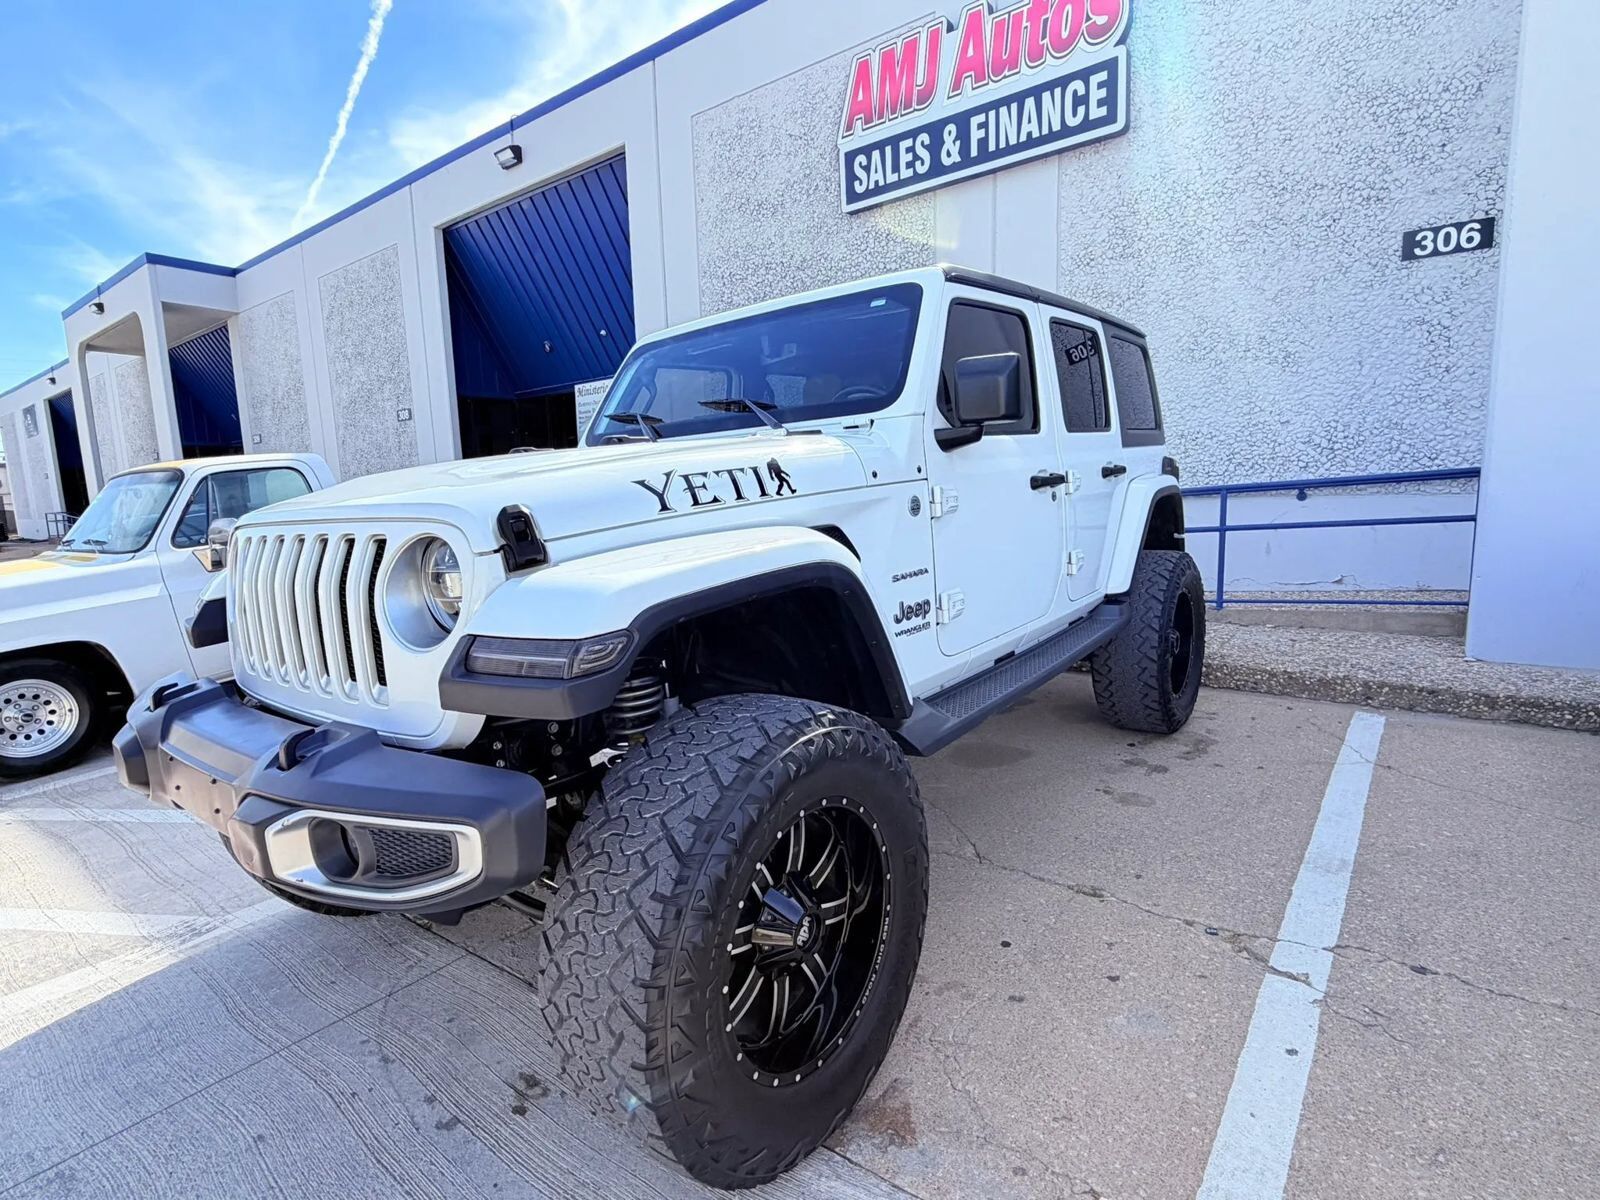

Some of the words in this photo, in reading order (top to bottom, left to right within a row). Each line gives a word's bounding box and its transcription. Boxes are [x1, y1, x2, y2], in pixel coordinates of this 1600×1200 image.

[843, 22, 943, 136] AMJ
[949, 0, 1123, 96] Autos
[853, 132, 931, 194] SALES
[940, 123, 961, 166] &
[970, 70, 1108, 158] FINANCE
[1413, 222, 1482, 256] 306
[631, 465, 772, 514] YETI
[891, 567, 930, 583] SAHARA
[893, 598, 931, 625] Jeep
[894, 621, 931, 638] WRANGLER
[875, 944, 885, 971] DIRT
[861, 973, 876, 1004] ROAD
